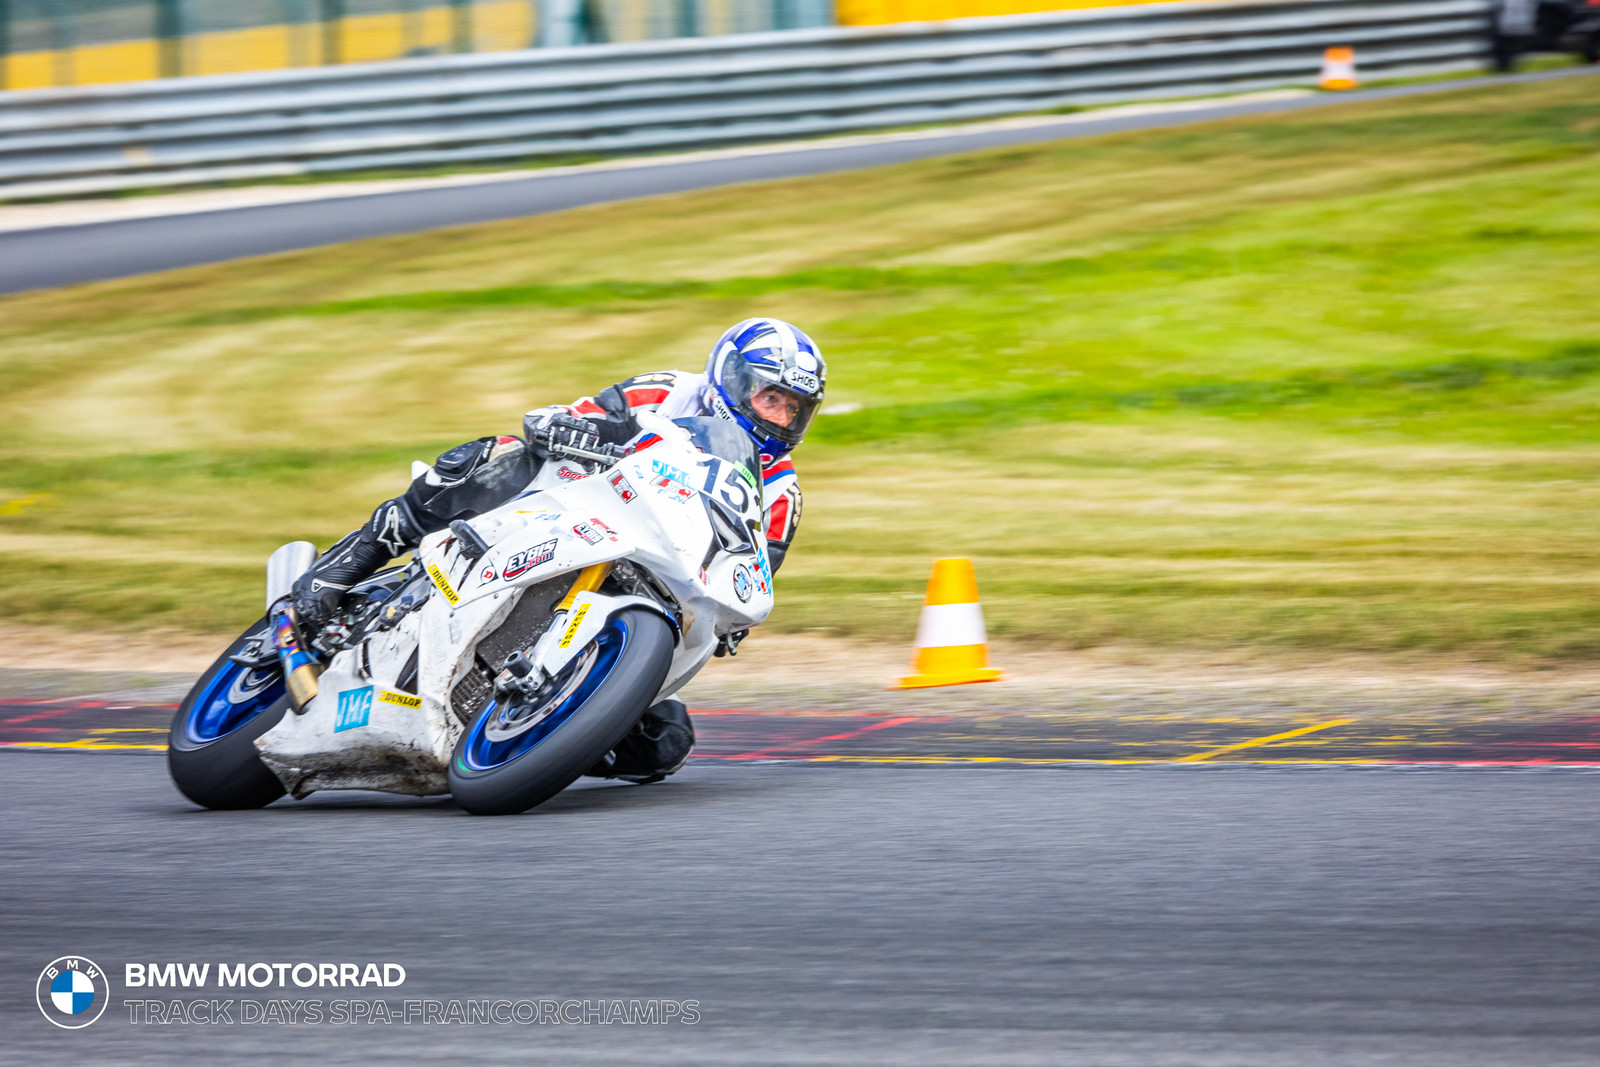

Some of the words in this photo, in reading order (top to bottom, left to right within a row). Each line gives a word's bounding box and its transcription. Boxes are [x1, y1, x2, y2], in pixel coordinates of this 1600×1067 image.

[508, 539, 558, 570] EYBIS
[432, 570, 459, 603] DUNLOP
[385, 693, 422, 708] DUNLOP
